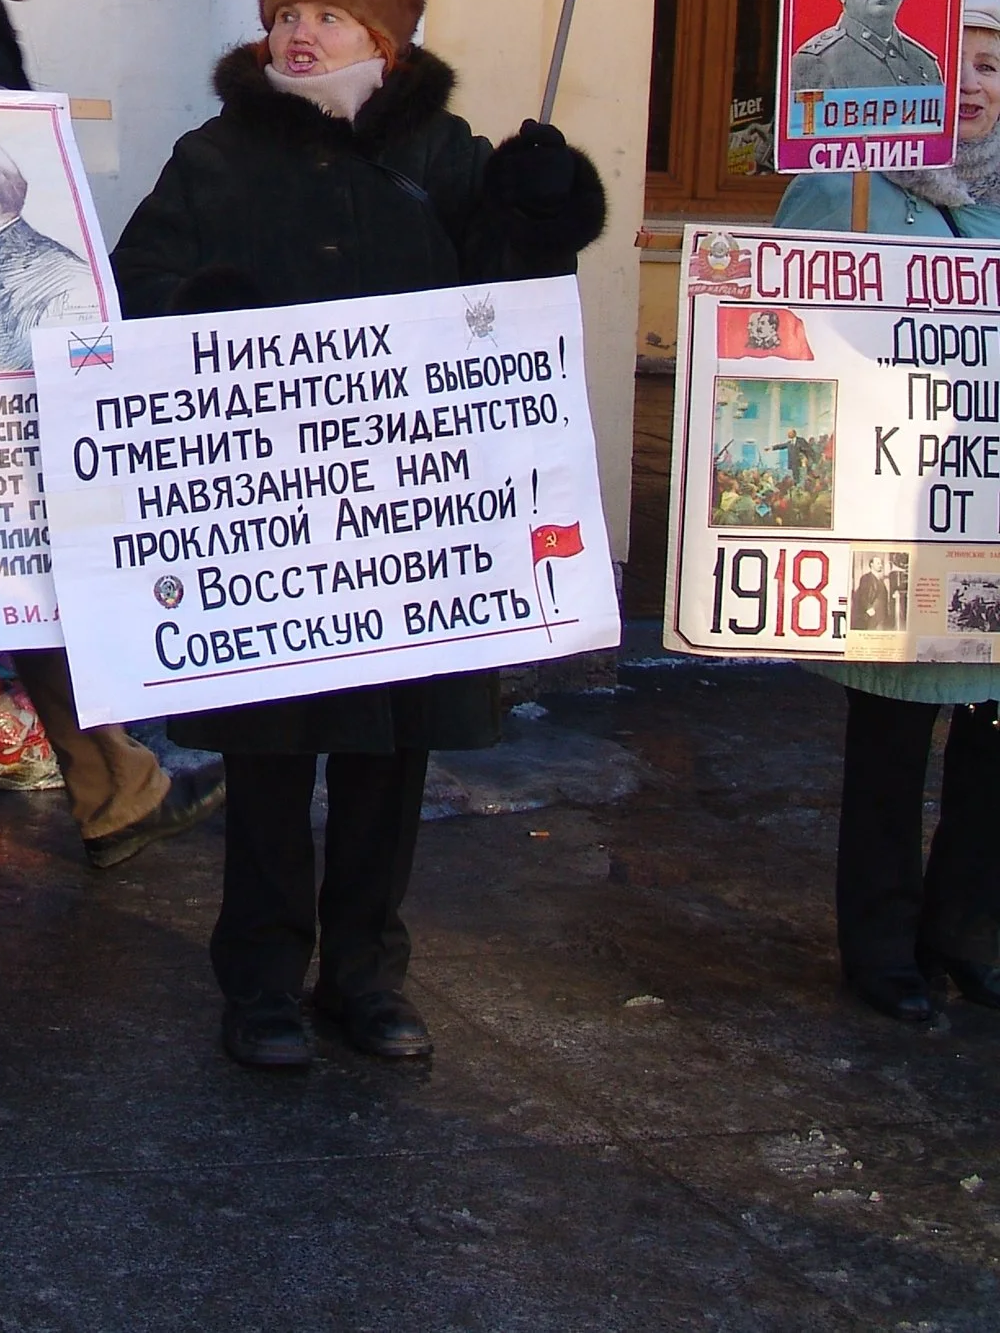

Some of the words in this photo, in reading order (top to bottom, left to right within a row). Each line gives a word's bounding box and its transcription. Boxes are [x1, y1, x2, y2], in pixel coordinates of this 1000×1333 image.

[794, 91, 941, 135] ТОВАРИЩ
[809, 141, 925, 170] СТАЛИН
[757, 242, 883, 302] СЛАВА
[906, 254, 1000, 309] ДОБЛ
[193, 324, 391, 374] НИКАКИХ
[96, 368, 408, 432] ПРЕЗИДЕНТСКИХ
[425, 335, 567, 394] ВЫБОРОВ!
[908, 372, 1000, 423] ПРОШ
[73, 428, 273, 480] ОТМЕНИТЬ
[298, 393, 569, 454] ПРЕЗИДЕНТСТВО,
[875, 426, 901, 476] К
[918, 434, 1000, 478] РАКЕ
[138, 459, 376, 520] НАВЯЗАННОЕ
[398, 449, 470, 488] НАМ
[930, 484, 974, 533] ОТ
[113, 503, 310, 568] ПРОКЛЯТОЙ
[335, 469, 538, 541] АМЕРИКОЙ!
[198, 542, 493, 611] ВОССТАНОВИТЬ
[3, 605, 48, 625] В.И.
[155, 604, 382, 670] СОВЕТСКУЮ
